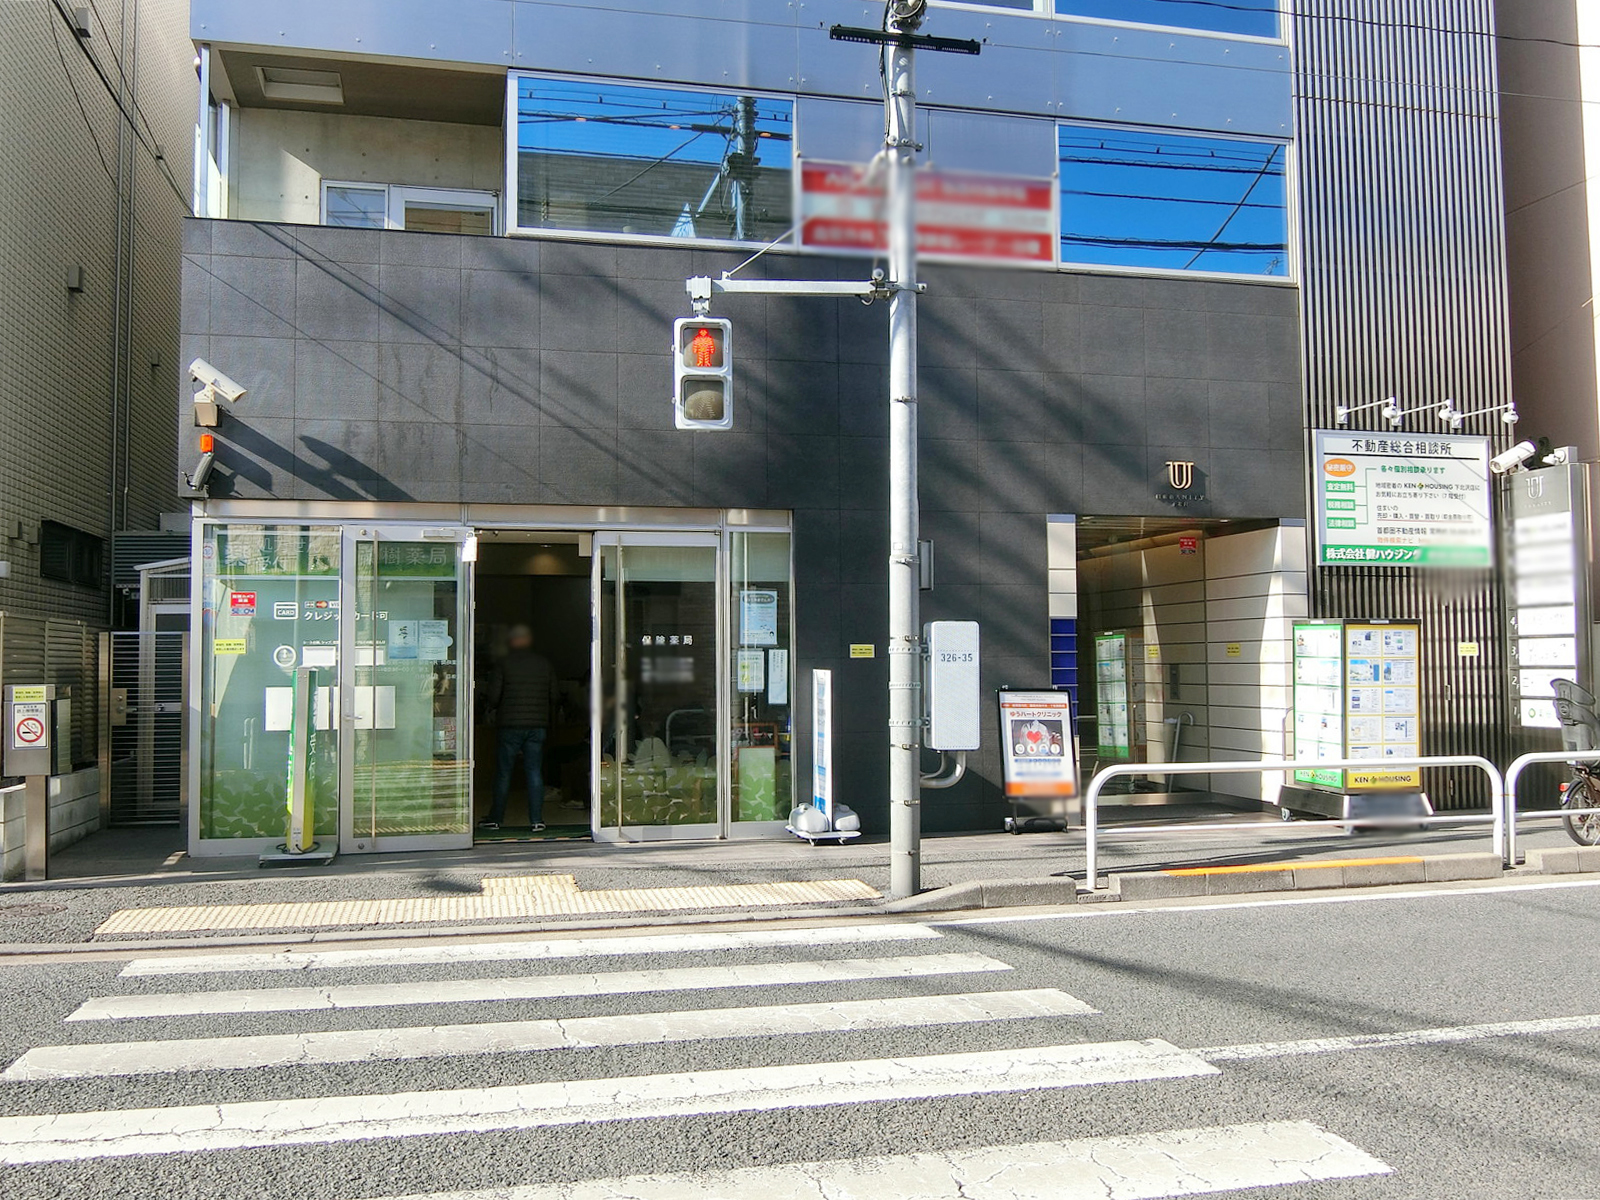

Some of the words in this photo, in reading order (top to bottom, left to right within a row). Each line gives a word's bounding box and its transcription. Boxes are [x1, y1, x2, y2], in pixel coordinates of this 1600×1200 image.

[1352, 439, 1452, 455] 不動産総合相談所
[1424, 483, 1454, 491] HOUSING
[1376, 526, 1428, 535] 首都圏不動産情報
[277, 608, 295, 616] CARD
[304, 611, 389, 621] クレジッカード可
[641, 634, 694, 646] 保険薬局
[940, 652, 973, 663] 326-35
[1009, 710, 1062, 718] ゆうハートクリニック
[1379, 775, 1412, 784] HOUSING
